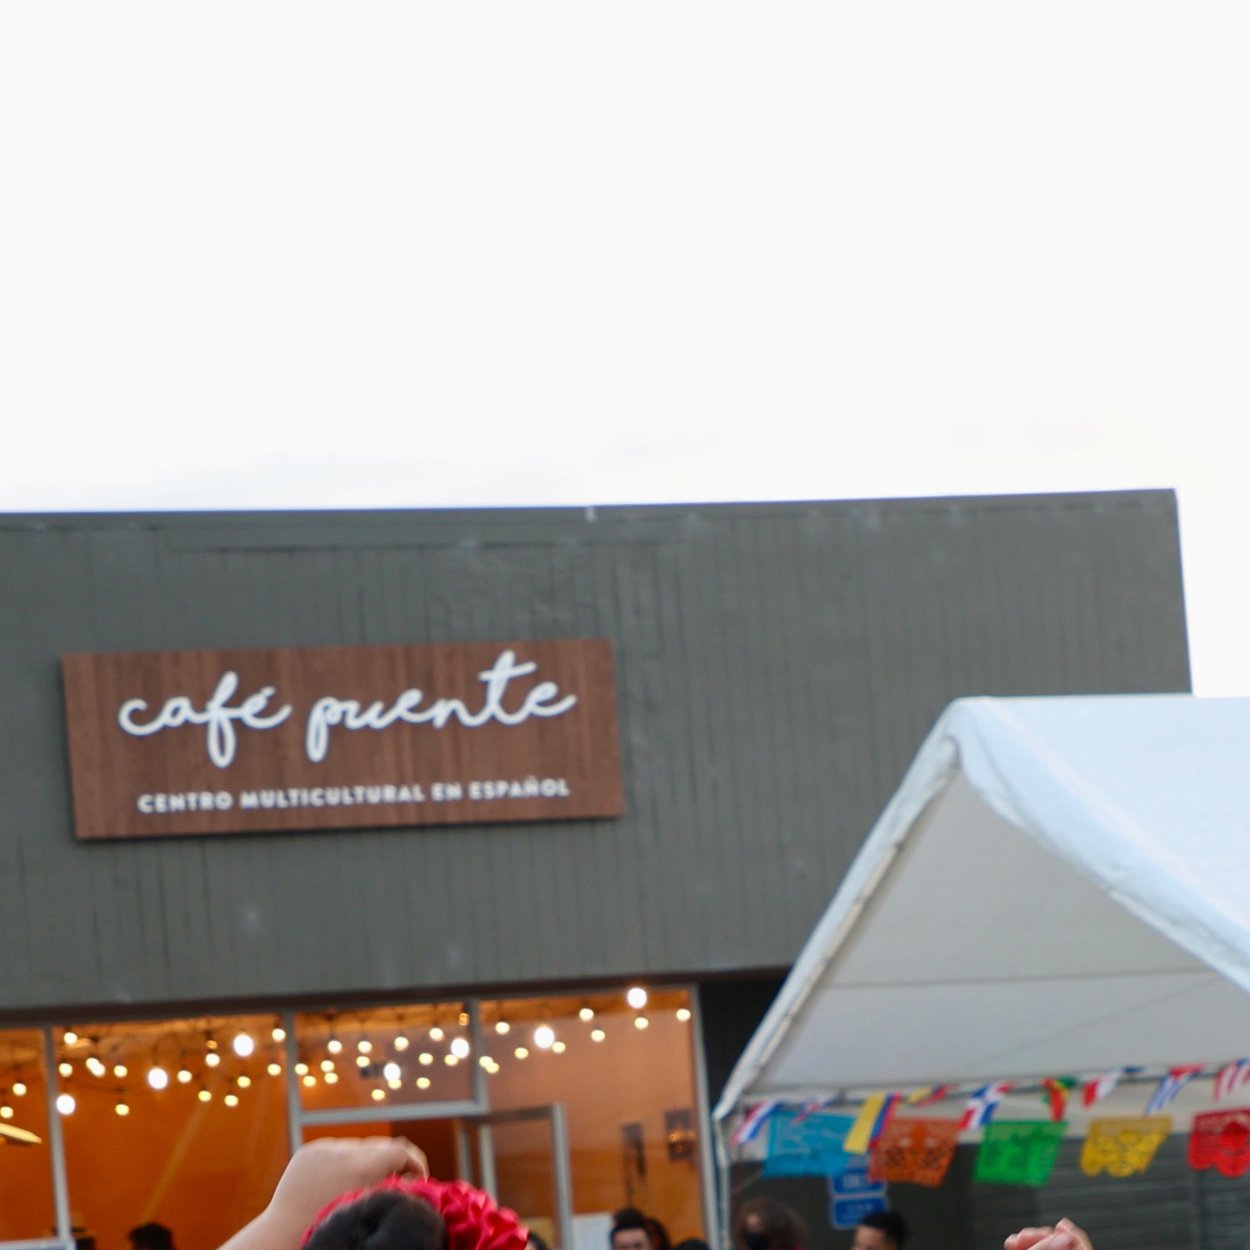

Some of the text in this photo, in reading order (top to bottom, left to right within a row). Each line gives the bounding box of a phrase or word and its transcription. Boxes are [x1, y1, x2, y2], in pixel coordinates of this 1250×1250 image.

[119, 650, 576, 768] café puente
[137, 775, 570, 813] CENTRO MULTICULTURAL EN ESPAÑOL
